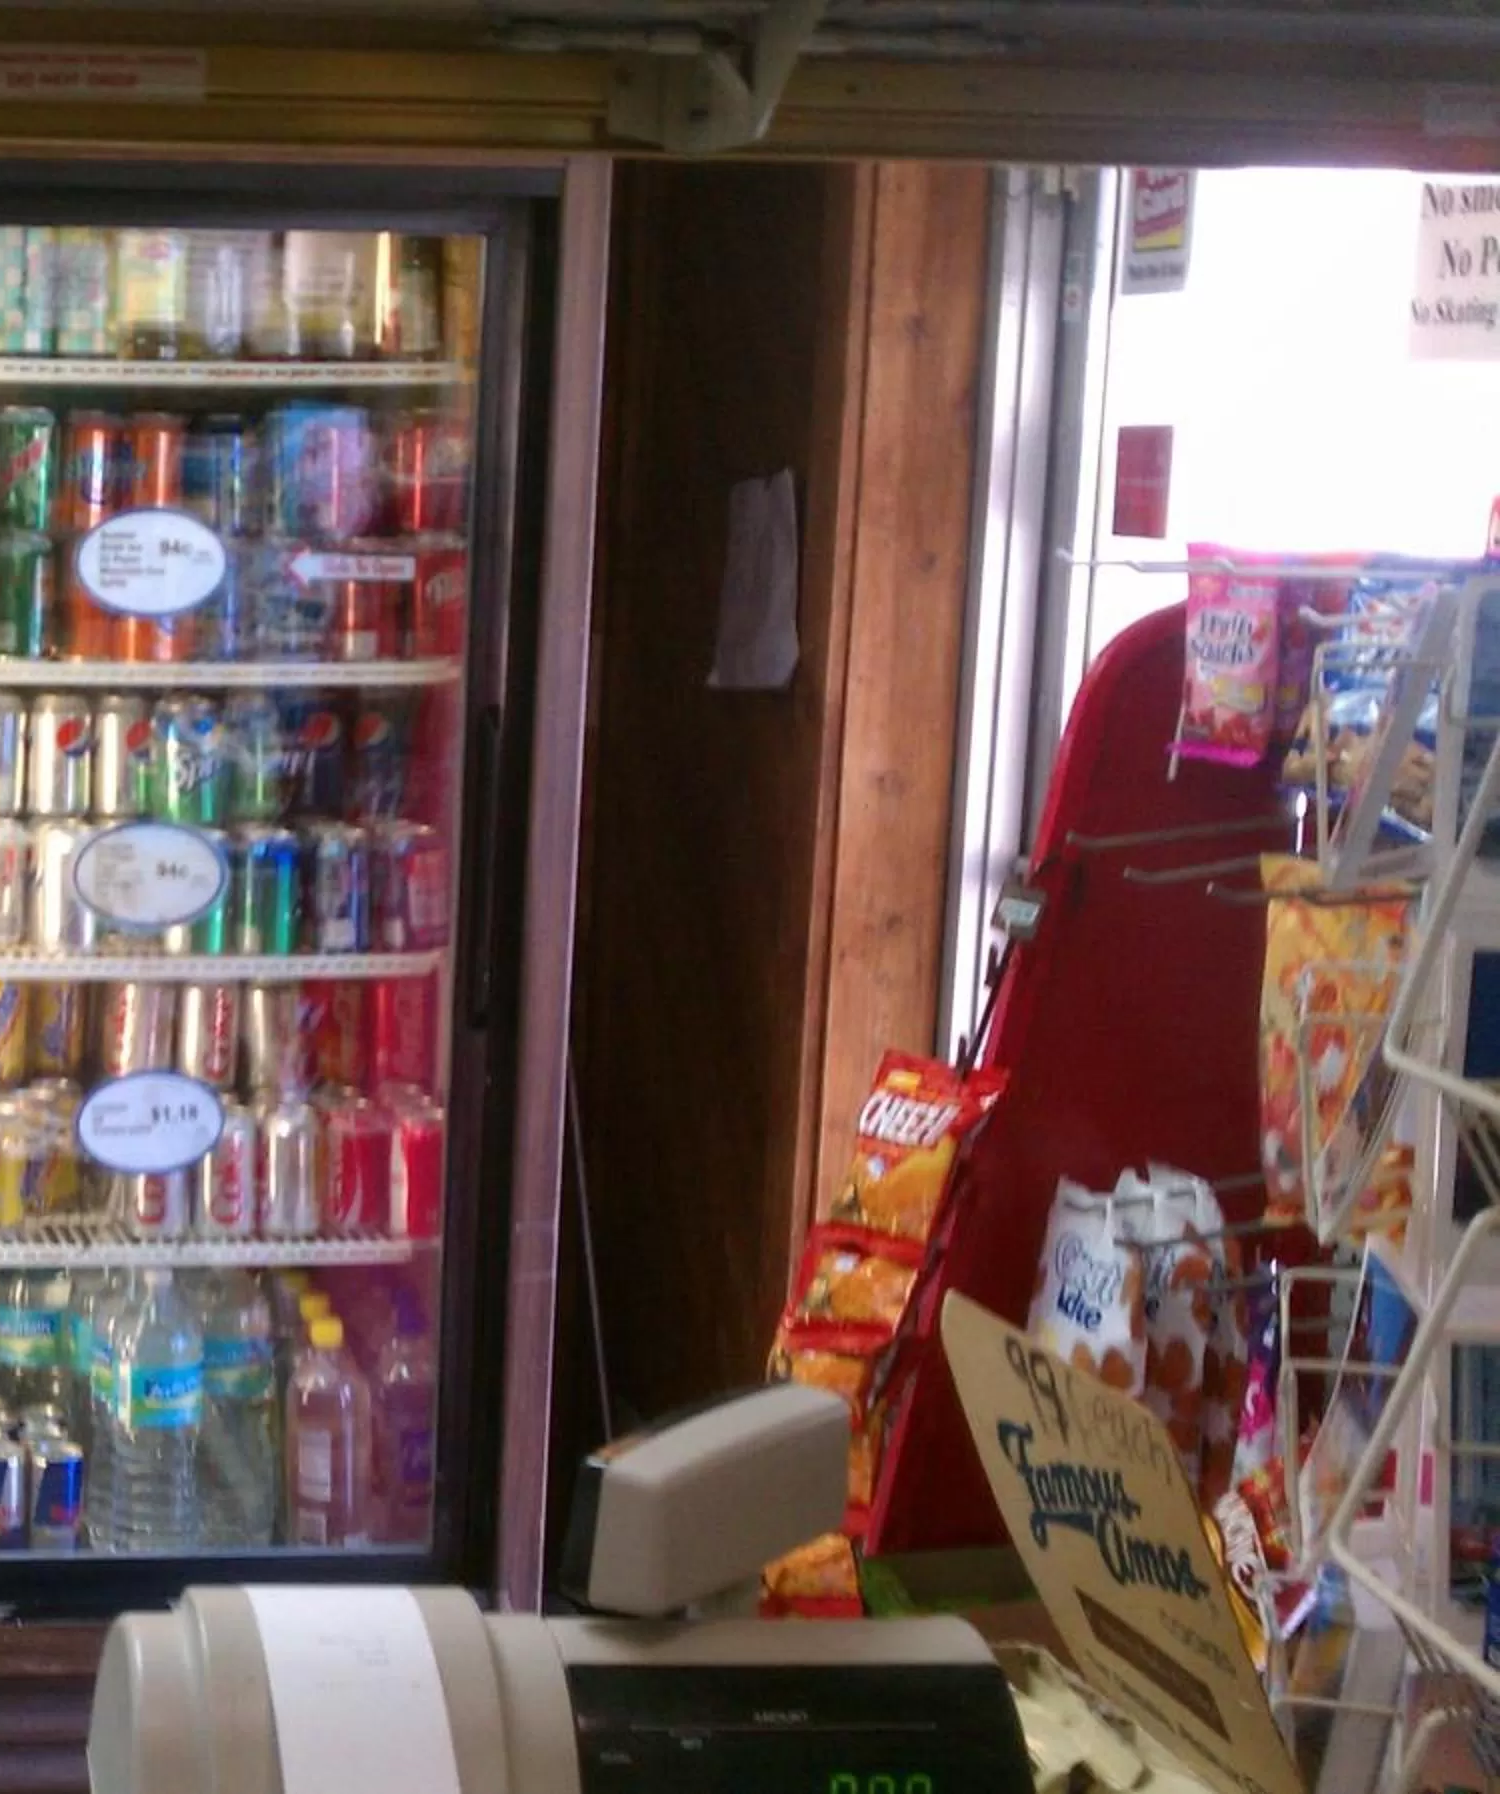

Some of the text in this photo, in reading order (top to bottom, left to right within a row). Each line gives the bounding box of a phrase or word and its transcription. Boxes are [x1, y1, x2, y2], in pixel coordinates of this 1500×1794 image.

[1421, 182, 1455, 217] No
[1438, 239, 1472, 279] No
[997, 1417, 1142, 1550] Famous
[1098, 1514, 1210, 1600] Amos
